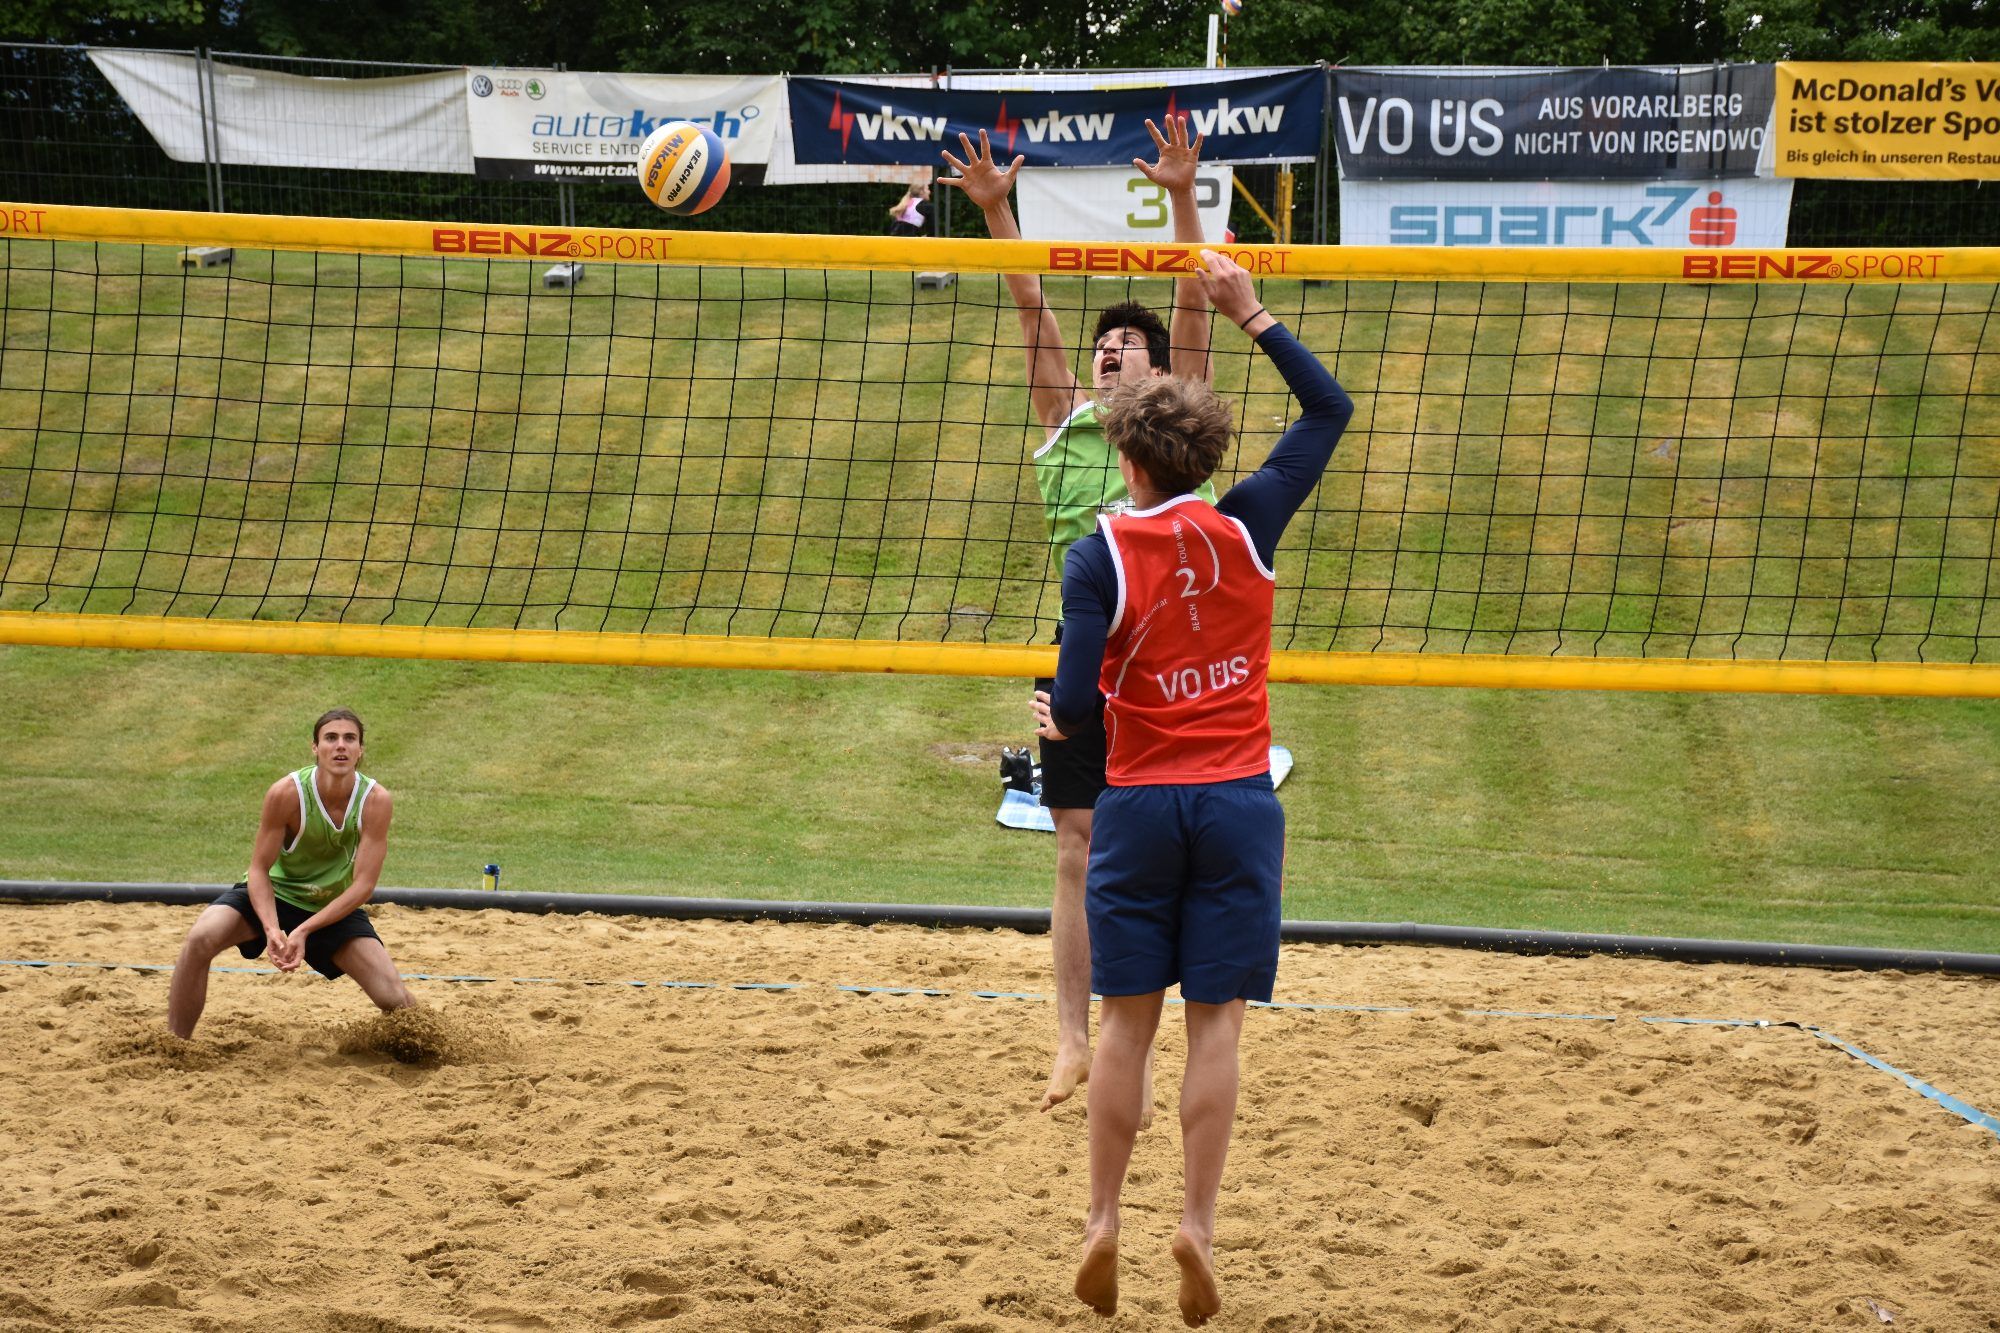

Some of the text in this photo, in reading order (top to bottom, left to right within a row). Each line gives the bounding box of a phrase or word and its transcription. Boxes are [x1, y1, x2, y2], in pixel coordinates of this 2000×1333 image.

[1975, 79, 2000, 102] V
[1190, 98, 1285, 136] vkw
[1538, 97, 1584, 120] AUS
[1590, 94, 1743, 120] VORARLBERG
[532, 110, 741, 138] autokh
[856, 106, 947, 141] vkw
[1023, 110, 1115, 142] vkw
[1338, 97, 1504, 156] VO ÜS
[1789, 109, 1827, 133] ist
[1833, 110, 1936, 134] stolzer
[1943, 111, 2000, 141] Spo
[532, 142, 593, 156] SERVICE
[1514, 127, 1765, 155] NICHT VON IRGENDWO
[646, 134, 685, 188] MIKASA
[1786, 150, 1809, 163] Bis
[1812, 150, 1859, 165] gleich
[1862, 150, 1877, 163] in
[1880, 152, 1943, 164] unseren
[667, 149, 702, 202] BEACH PRO
[1175, 567, 1200, 598] 2
[1189, 603, 1201, 631] BEACH
[1157, 668, 1201, 702] VO
